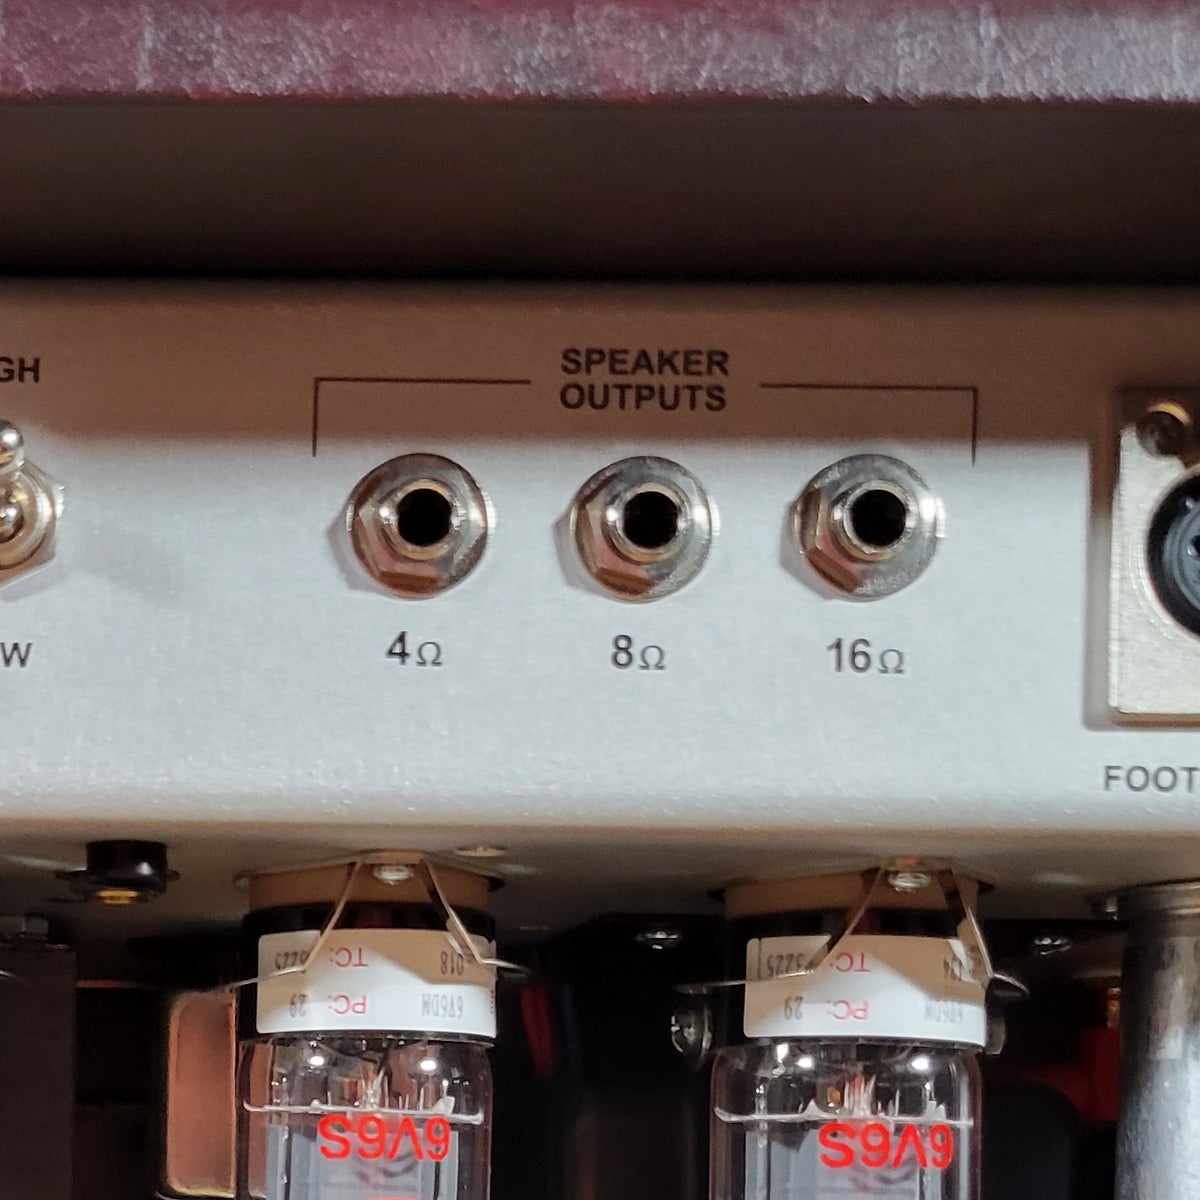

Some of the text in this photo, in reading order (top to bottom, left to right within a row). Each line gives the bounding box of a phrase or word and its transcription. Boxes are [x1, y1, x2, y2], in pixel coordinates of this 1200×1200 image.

[560, 348, 730, 376] SPEAKER
[560, 383, 728, 412] OUTPUTS
[783, 996, 804, 1021] 29
[317, 1114, 451, 1161] 6V6S
[817, 1122, 954, 1168] 6V6S
